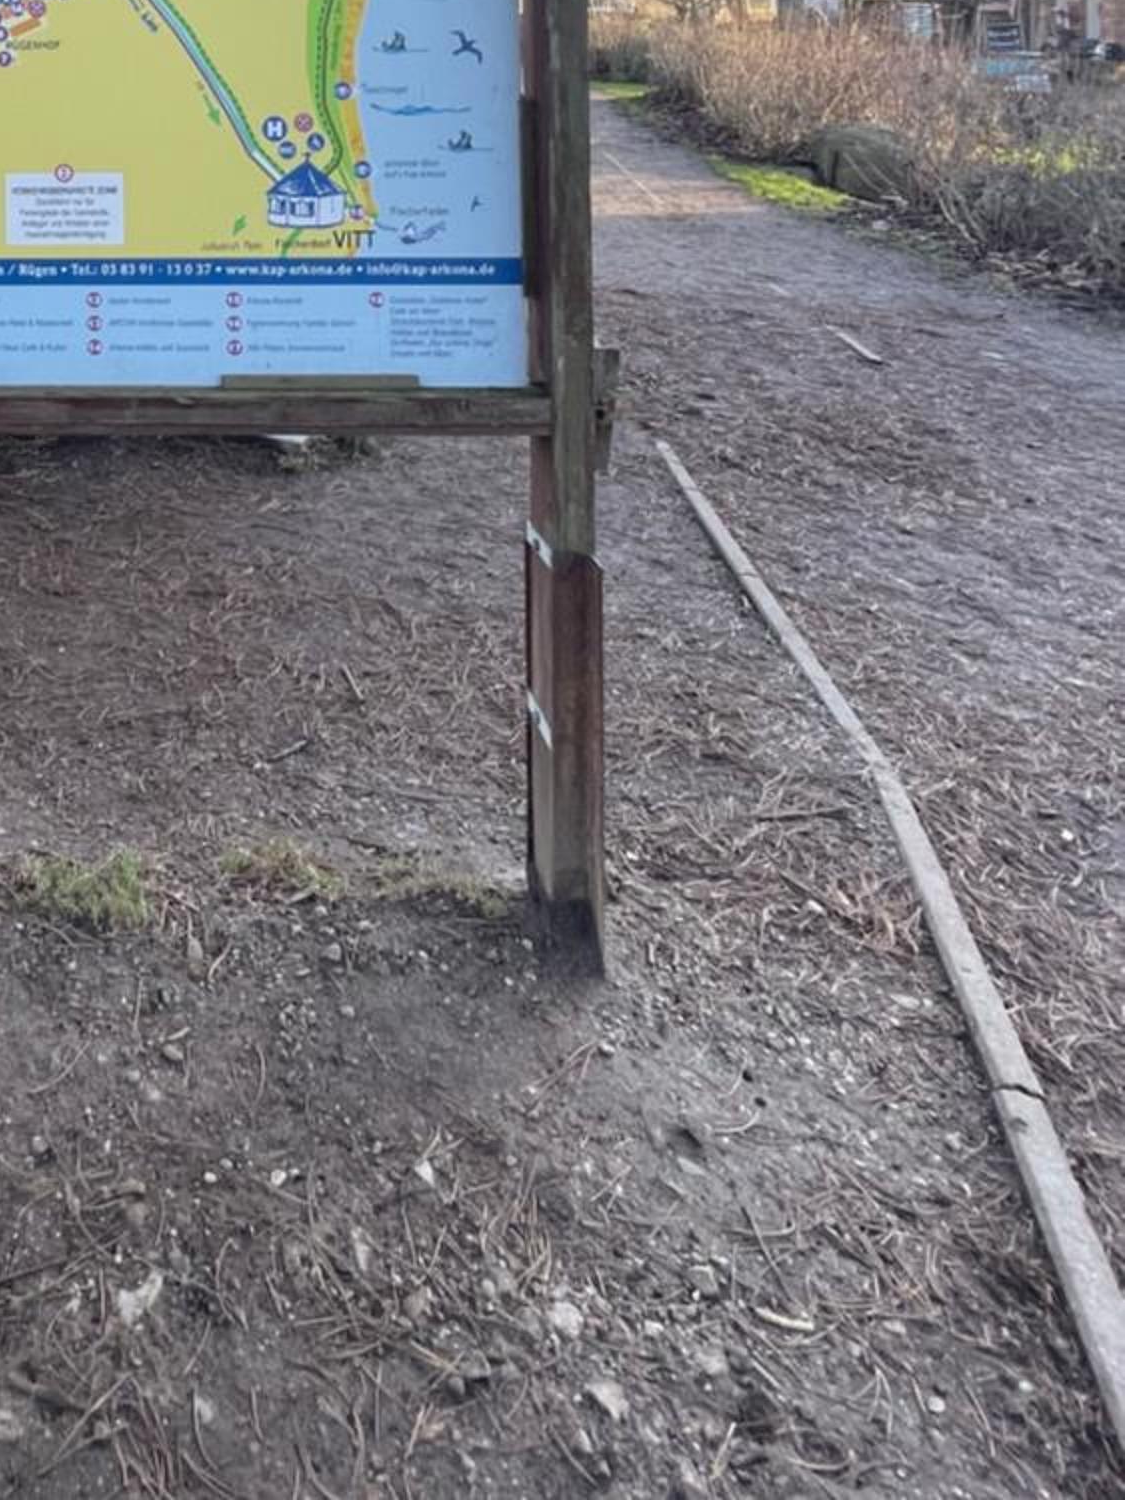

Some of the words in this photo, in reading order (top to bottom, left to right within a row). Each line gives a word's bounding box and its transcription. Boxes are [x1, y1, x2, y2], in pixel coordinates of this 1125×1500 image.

[332, 230, 376, 250] VITT
[18, 262, 58, 279] Rügen
[225, 262, 353, 279] www.kap-arkona.de
